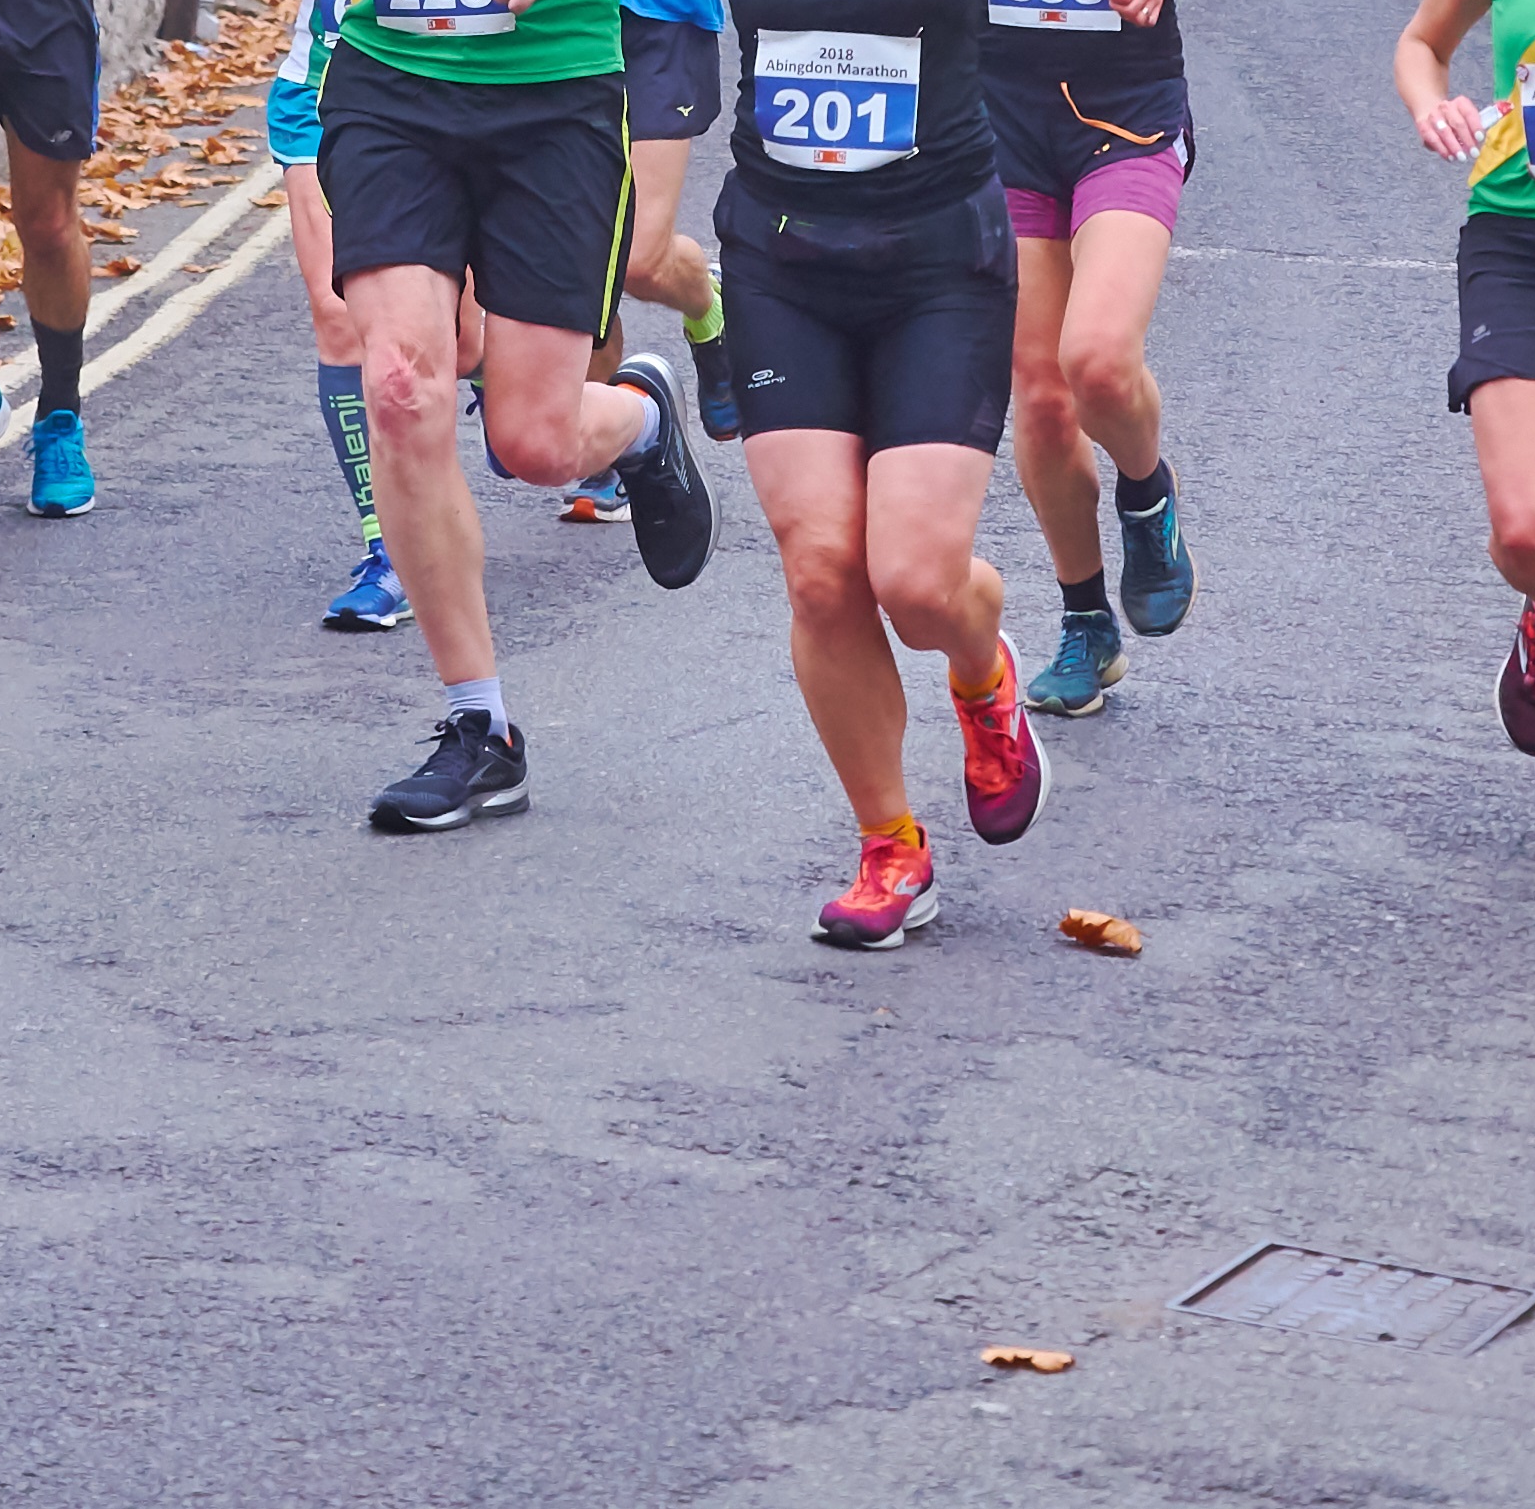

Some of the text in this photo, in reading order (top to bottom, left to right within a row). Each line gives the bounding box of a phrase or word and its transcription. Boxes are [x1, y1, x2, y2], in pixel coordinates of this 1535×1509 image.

[819, 47, 854, 61] 2018
[765, 59, 908, 79] Abingdon Marathon
[772, 88, 887, 143] 201
